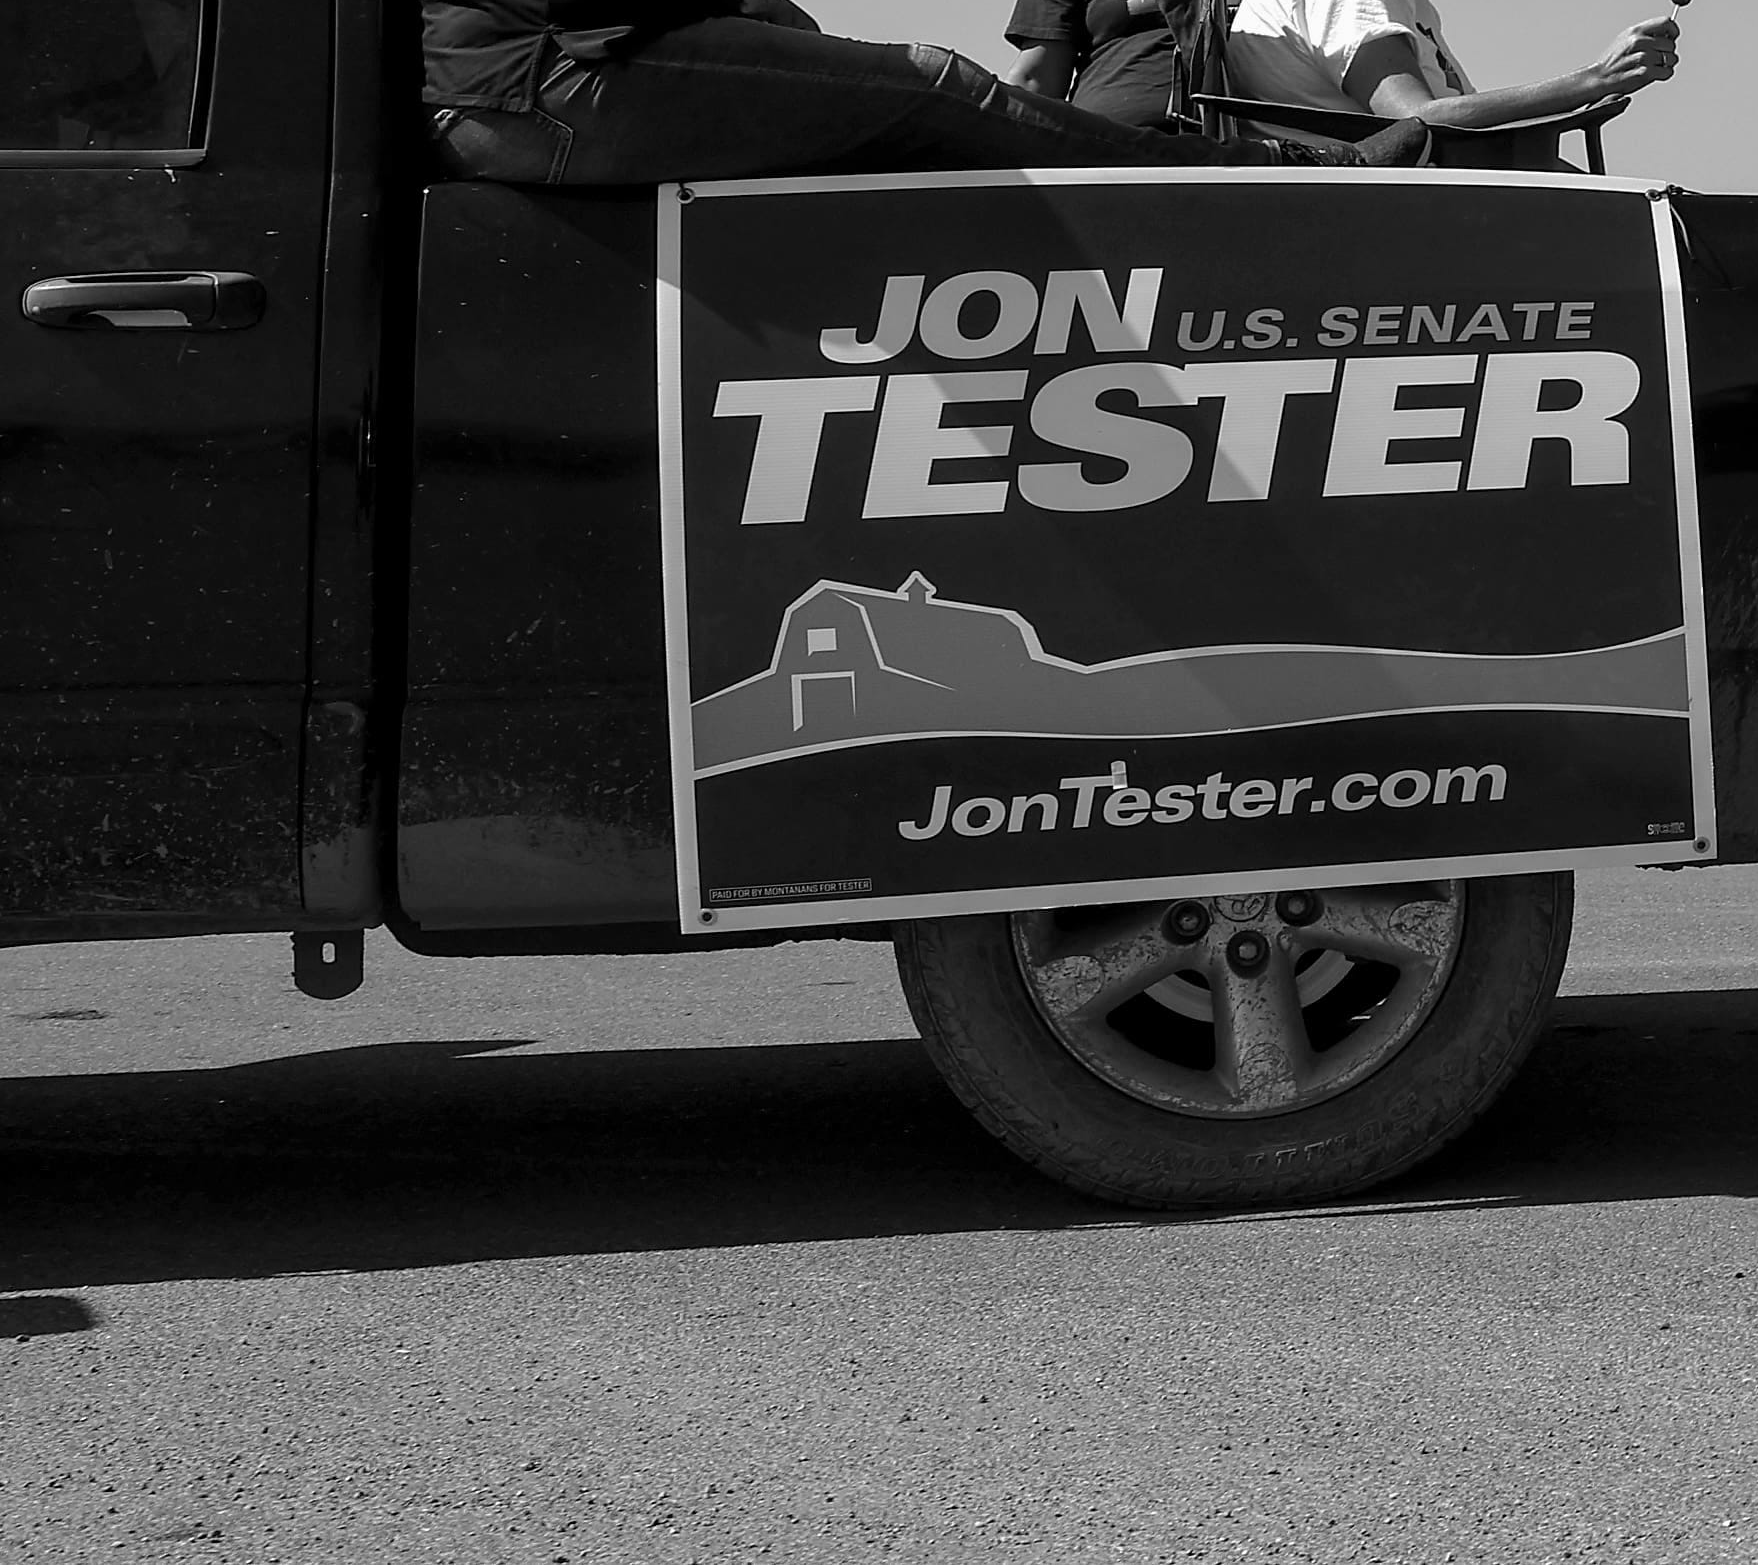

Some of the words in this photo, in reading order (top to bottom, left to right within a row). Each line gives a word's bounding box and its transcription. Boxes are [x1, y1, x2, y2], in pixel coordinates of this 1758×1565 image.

[819, 267, 1164, 364] JON
[1176, 309, 1299, 352] U.S.
[1317, 301, 1595, 347] SENATE
[713, 350, 1641, 525] TESTER
[898, 762, 1508, 840] JonTester.com
[711, 890, 732, 899] PAID
[733, 888, 750, 898] FOR
[751, 888, 762, 897] BY
[764, 884, 818, 896] MONTANANS
[819, 883, 836, 893] FOR
[838, 881, 869, 891] TESTER
